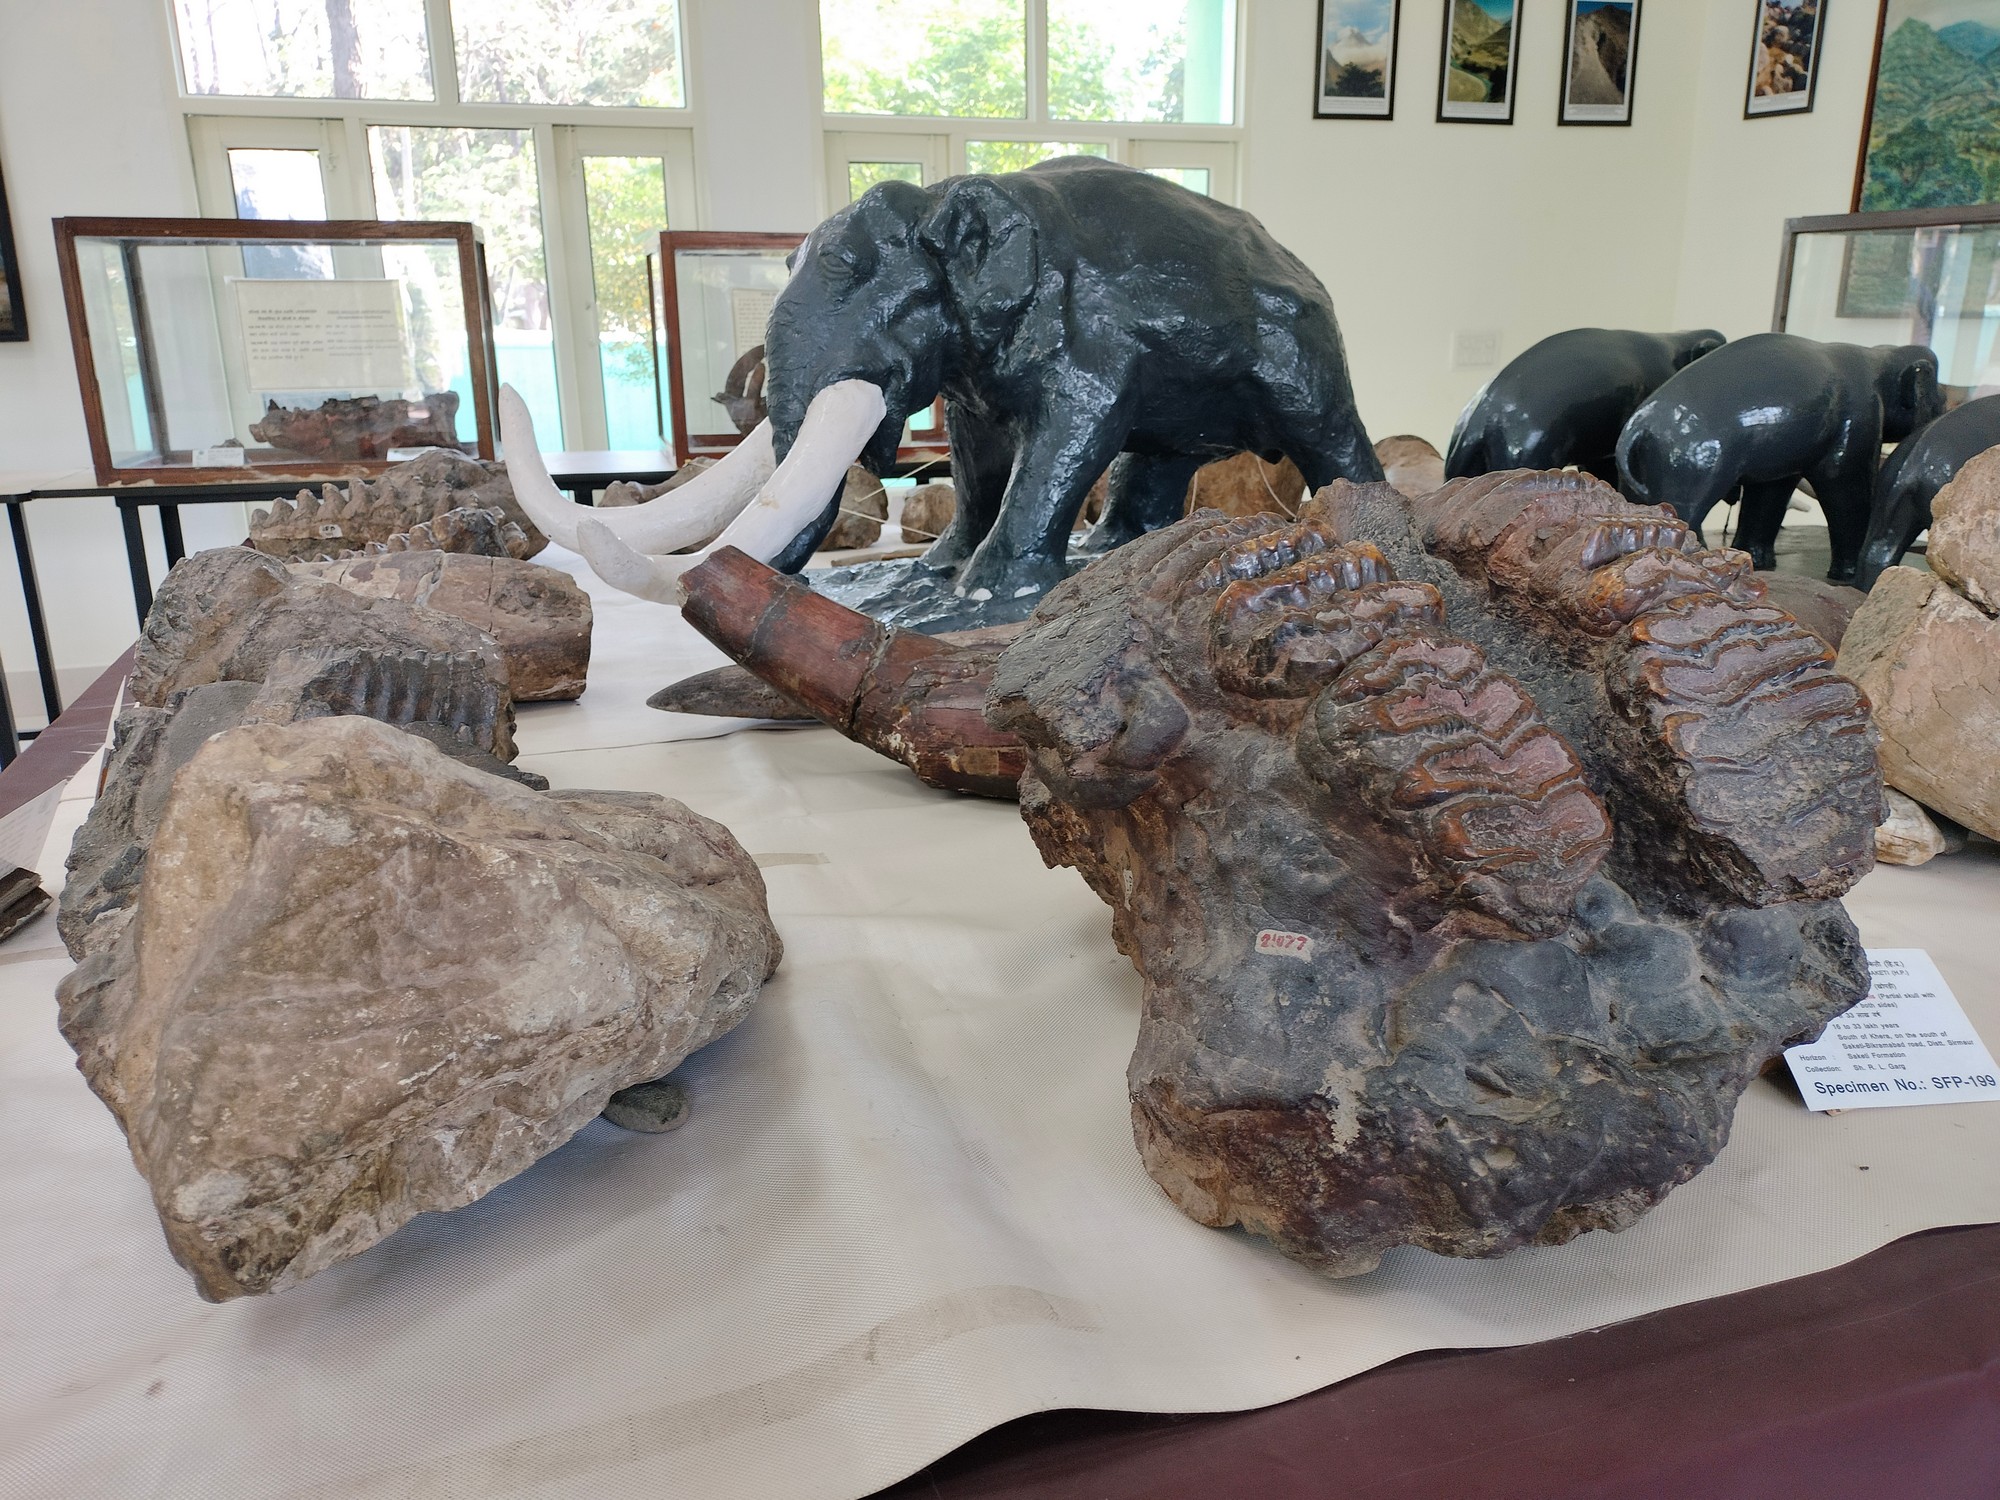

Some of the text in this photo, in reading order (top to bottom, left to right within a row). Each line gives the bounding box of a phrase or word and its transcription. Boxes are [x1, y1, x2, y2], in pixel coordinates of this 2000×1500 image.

[1870, 969, 1890, 977] AKETI
[1881, 1023, 1900, 1031] years
[1799, 1054, 1827, 1062] Horizon
[1847, 1052, 1870, 1060] Saketi
[1871, 1051, 1906, 1059] Formation
[1889, 1063, 1906, 1071] Garg
[1814, 1075, 1996, 1096] Specimen No.: SFP-199
